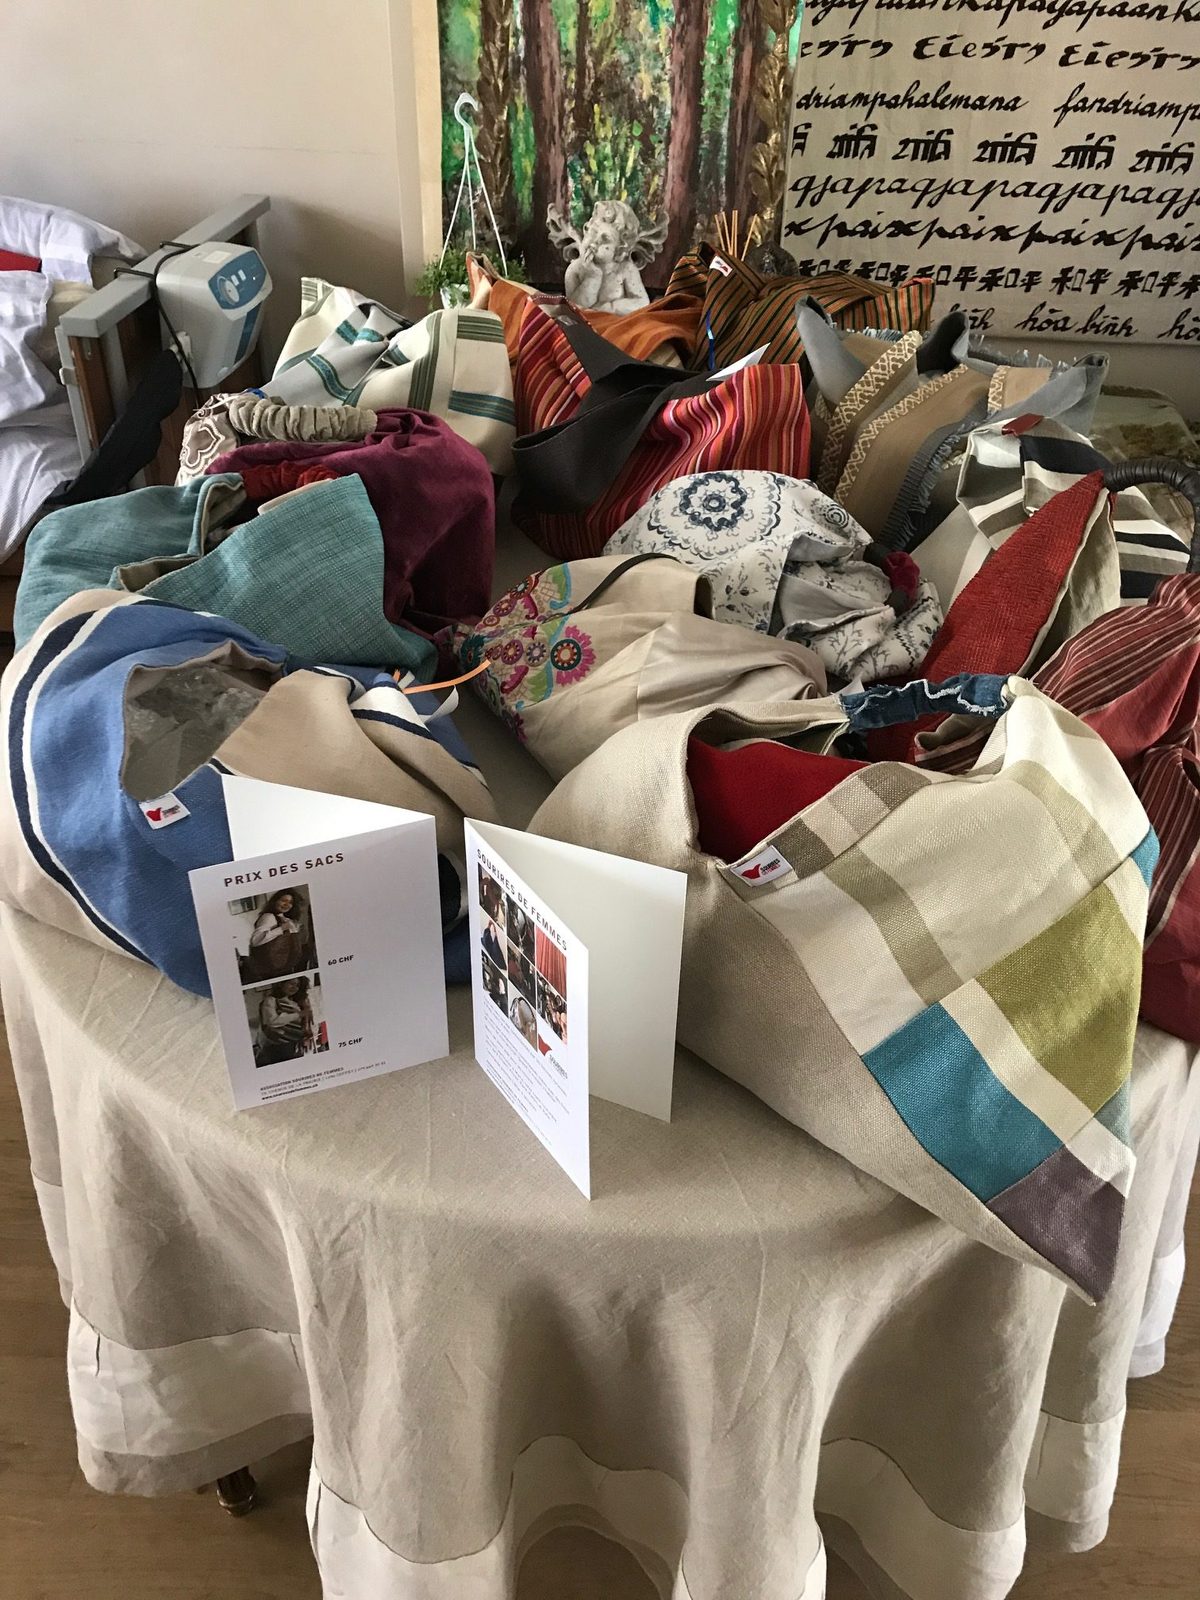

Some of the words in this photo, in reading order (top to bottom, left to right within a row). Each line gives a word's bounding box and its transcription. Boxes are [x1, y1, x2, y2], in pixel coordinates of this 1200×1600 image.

[223, 870, 263, 887] PRIX
[268, 863, 299, 878] DES
[305, 852, 344, 869] SACS
[477, 848, 515, 895] SOURIRES
[517, 892, 529, 909] DE
[531, 906, 567, 951] FEMMES
[338, 954, 354, 963] CHF
[348, 1037, 363, 1046] CHF
